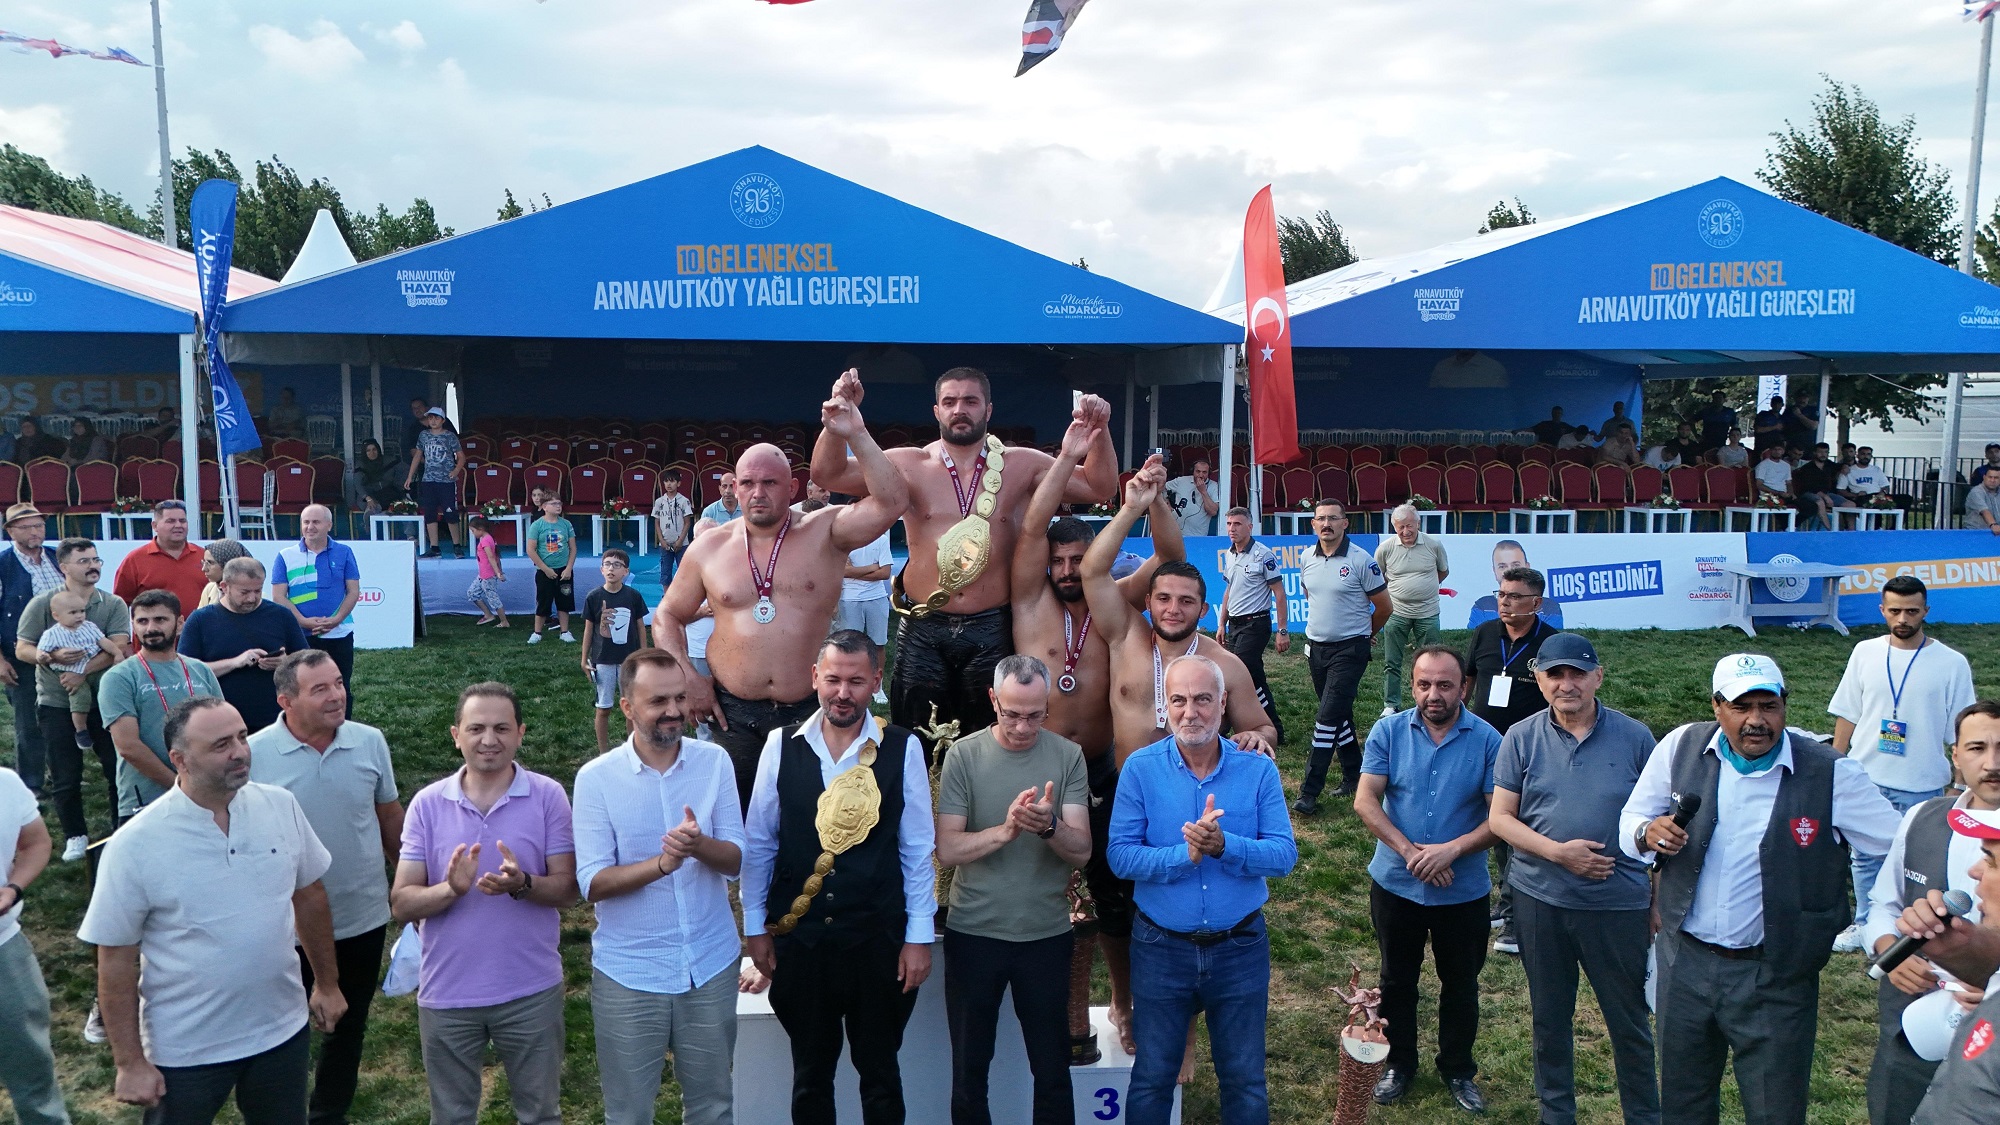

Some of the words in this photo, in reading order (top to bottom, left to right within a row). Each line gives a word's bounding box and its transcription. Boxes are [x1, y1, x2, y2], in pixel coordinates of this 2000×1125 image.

[734, 175, 781, 198] ARNAVUTKÖY
[1701, 201, 1741, 221] ARNAVUTKÖY
[707, 243, 838, 274] GELENEKSEL
[396, 268, 456, 282] ARNAVUTKÖY
[1676, 260, 1787, 289] GELENEKSEL
[404, 283, 449, 293] HAYAT
[594, 277, 738, 310] ARNAVUTKÖY
[743, 275, 804, 306] YAĞLI
[808, 275, 920, 308] GÜREŞLERİ
[1413, 286, 1464, 299] ARNAVUTKÖY
[1044, 305, 1120, 315] CANDAROĞLU
[1420, 300, 1458, 310] HAYAT
[1577, 292, 1702, 324] ARNAVUTKÖY
[1705, 290, 1756, 319] YAĞLI
[1760, 288, 1855, 319] GÜREŞLERİ
[1960, 315, 2000, 325] CANDAR
[1552, 573, 1586, 599] HOŞ
[1589, 563, 1658, 594] GELDİNİZ
[1896, 560, 2000, 585] GELDİNİ
[1689, 591, 1733, 599] CANDAROĞL
[1954, 814, 1980, 829] TGGF
[1093, 1088, 1120, 1120] 3
